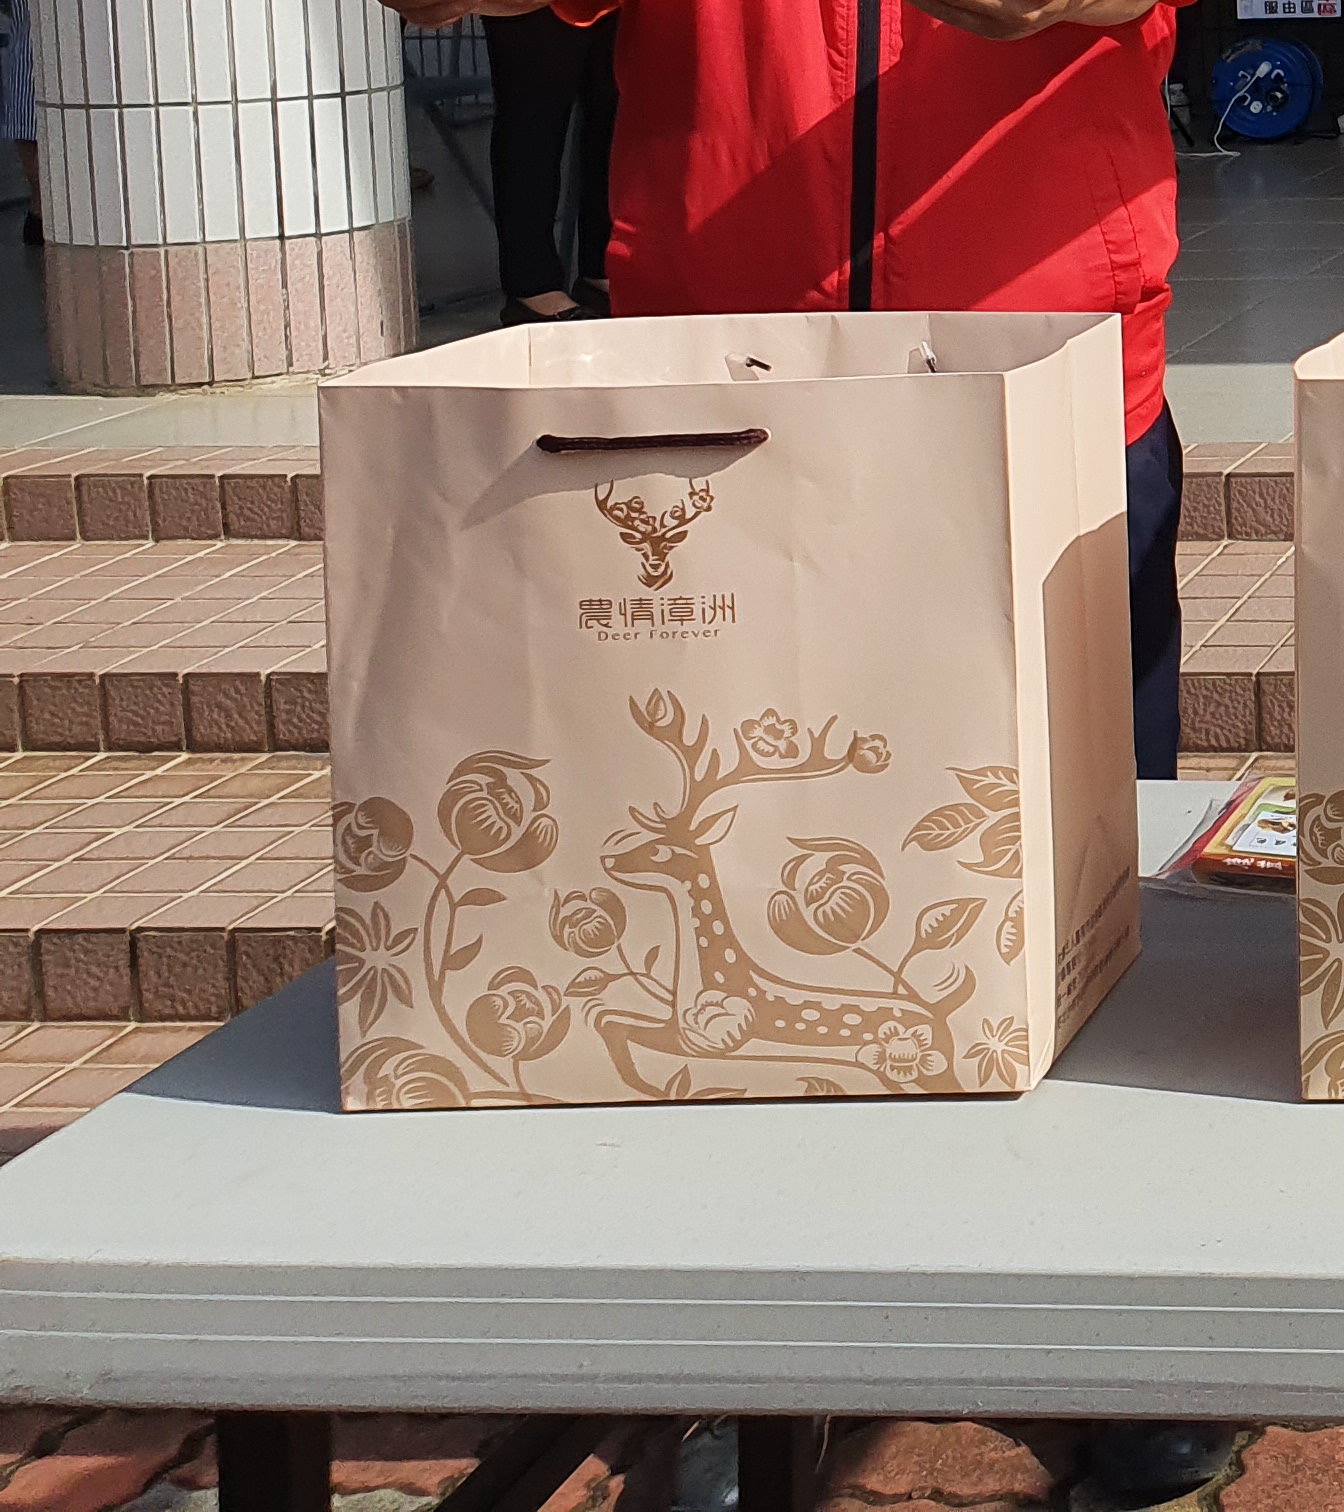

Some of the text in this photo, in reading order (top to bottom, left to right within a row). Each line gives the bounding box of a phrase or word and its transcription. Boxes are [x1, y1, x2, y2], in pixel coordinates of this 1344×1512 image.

[577, 591, 737, 630] 農情漳洲
[597, 627, 722, 642] Deer Forever
